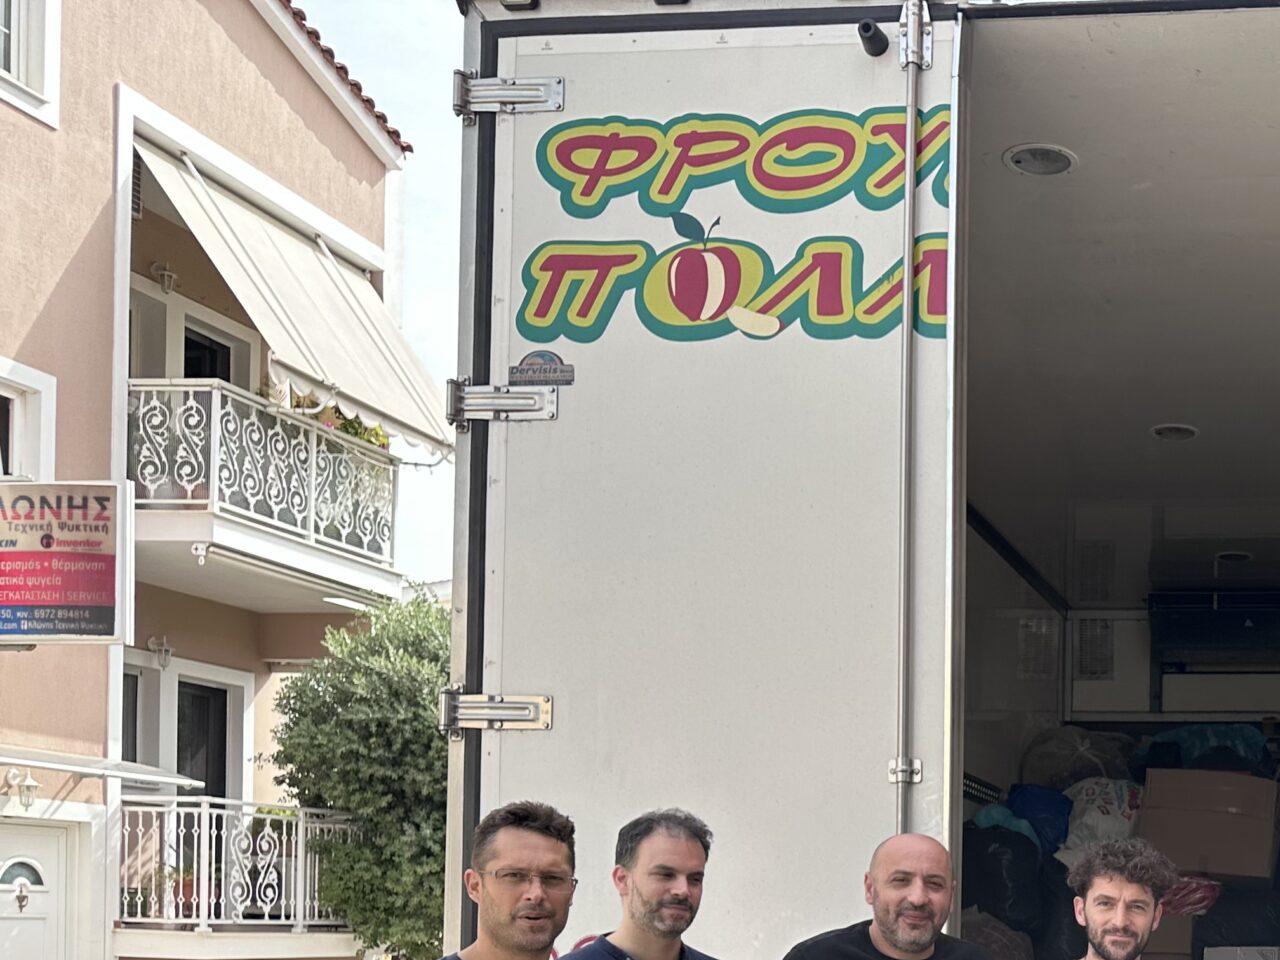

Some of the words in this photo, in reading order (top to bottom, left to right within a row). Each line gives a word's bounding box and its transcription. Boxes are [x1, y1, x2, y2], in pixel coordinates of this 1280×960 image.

[546, 111, 950, 210] ΦΡΟΥ
[7, 521, 53, 535] Τεχνική
[58, 522, 109, 535] Ψυκτική
[56, 538, 103, 548] inventor
[51, 558, 106, 573] θέρμανση
[26, 574, 62, 589] ψυγεία
